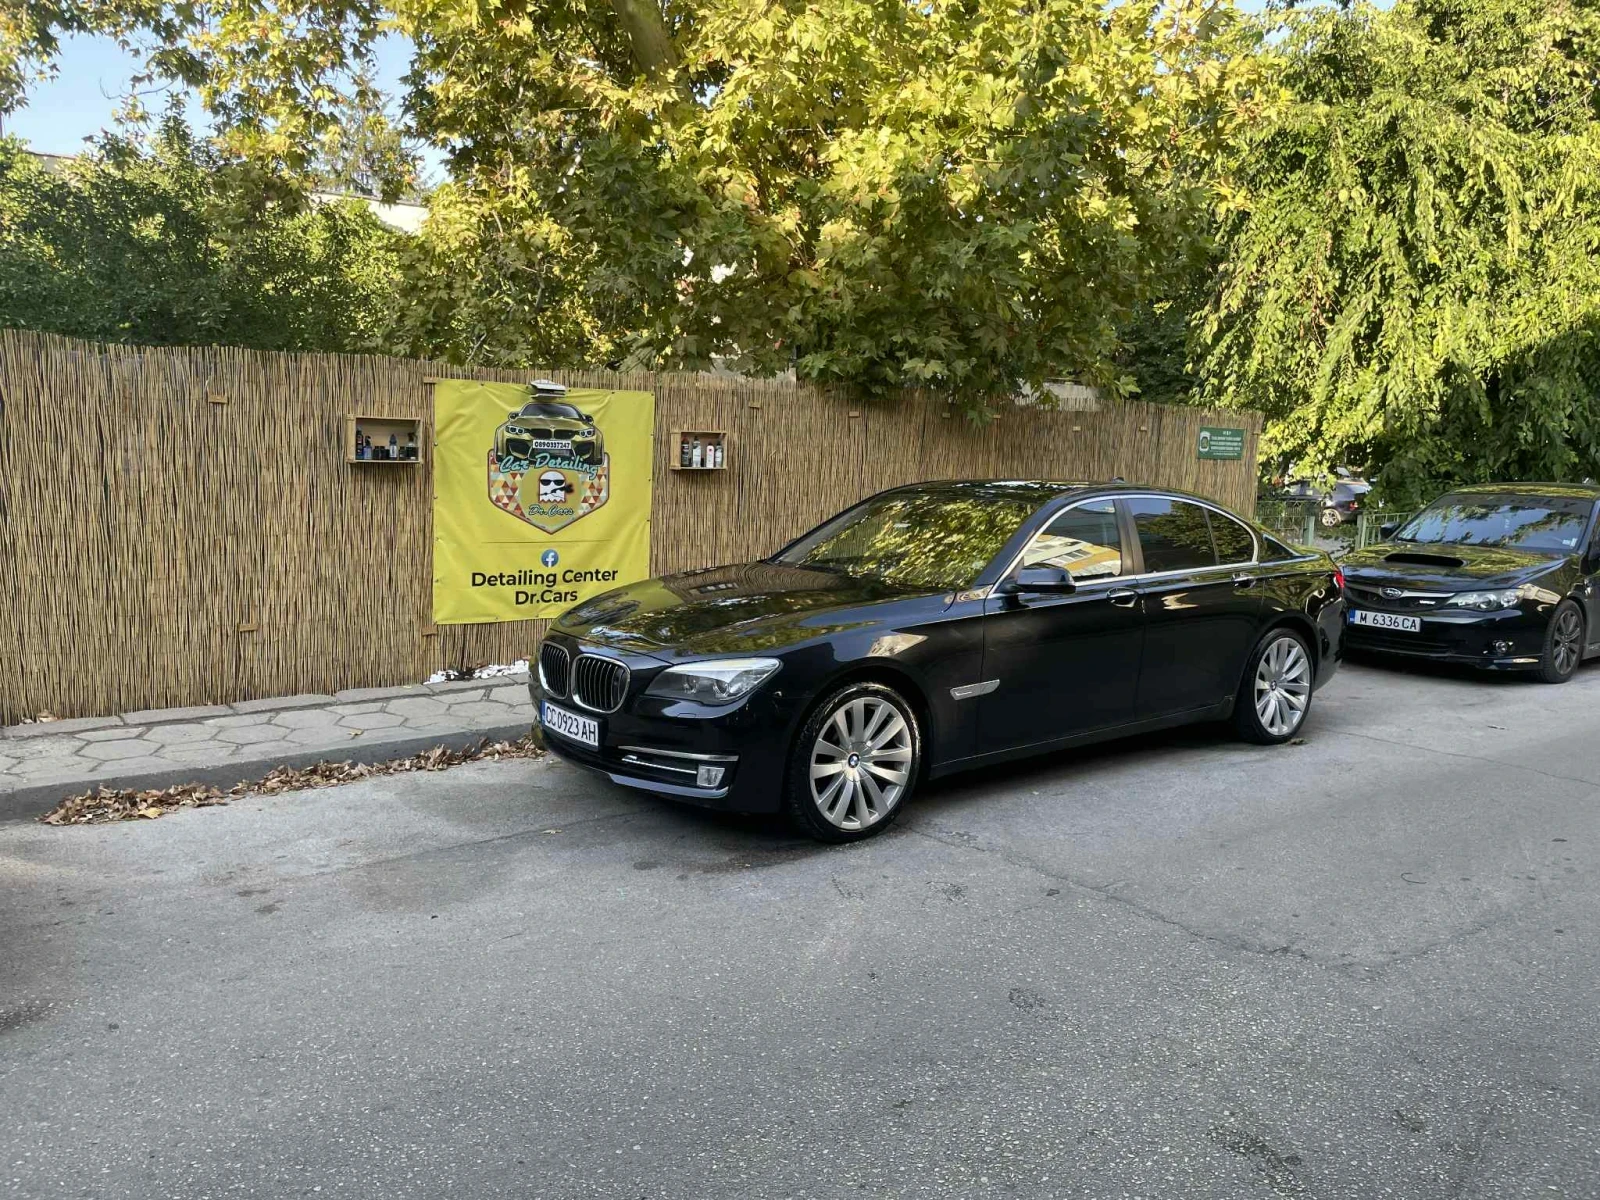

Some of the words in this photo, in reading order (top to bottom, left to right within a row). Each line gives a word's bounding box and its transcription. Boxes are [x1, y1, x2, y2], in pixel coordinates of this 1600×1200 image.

[500, 455, 530, 473] Car
[534, 452, 598, 480] Detailing
[471, 569, 557, 588] Detailing
[562, 568, 618, 584] Center
[1360, 612, 1368, 624] M
[1373, 613, 1399, 628] 6336
[1402, 617, 1417, 630] CA
[546, 706, 556, 726] CC
[557, 712, 579, 736] 0923
[581, 720, 596, 743] AH
